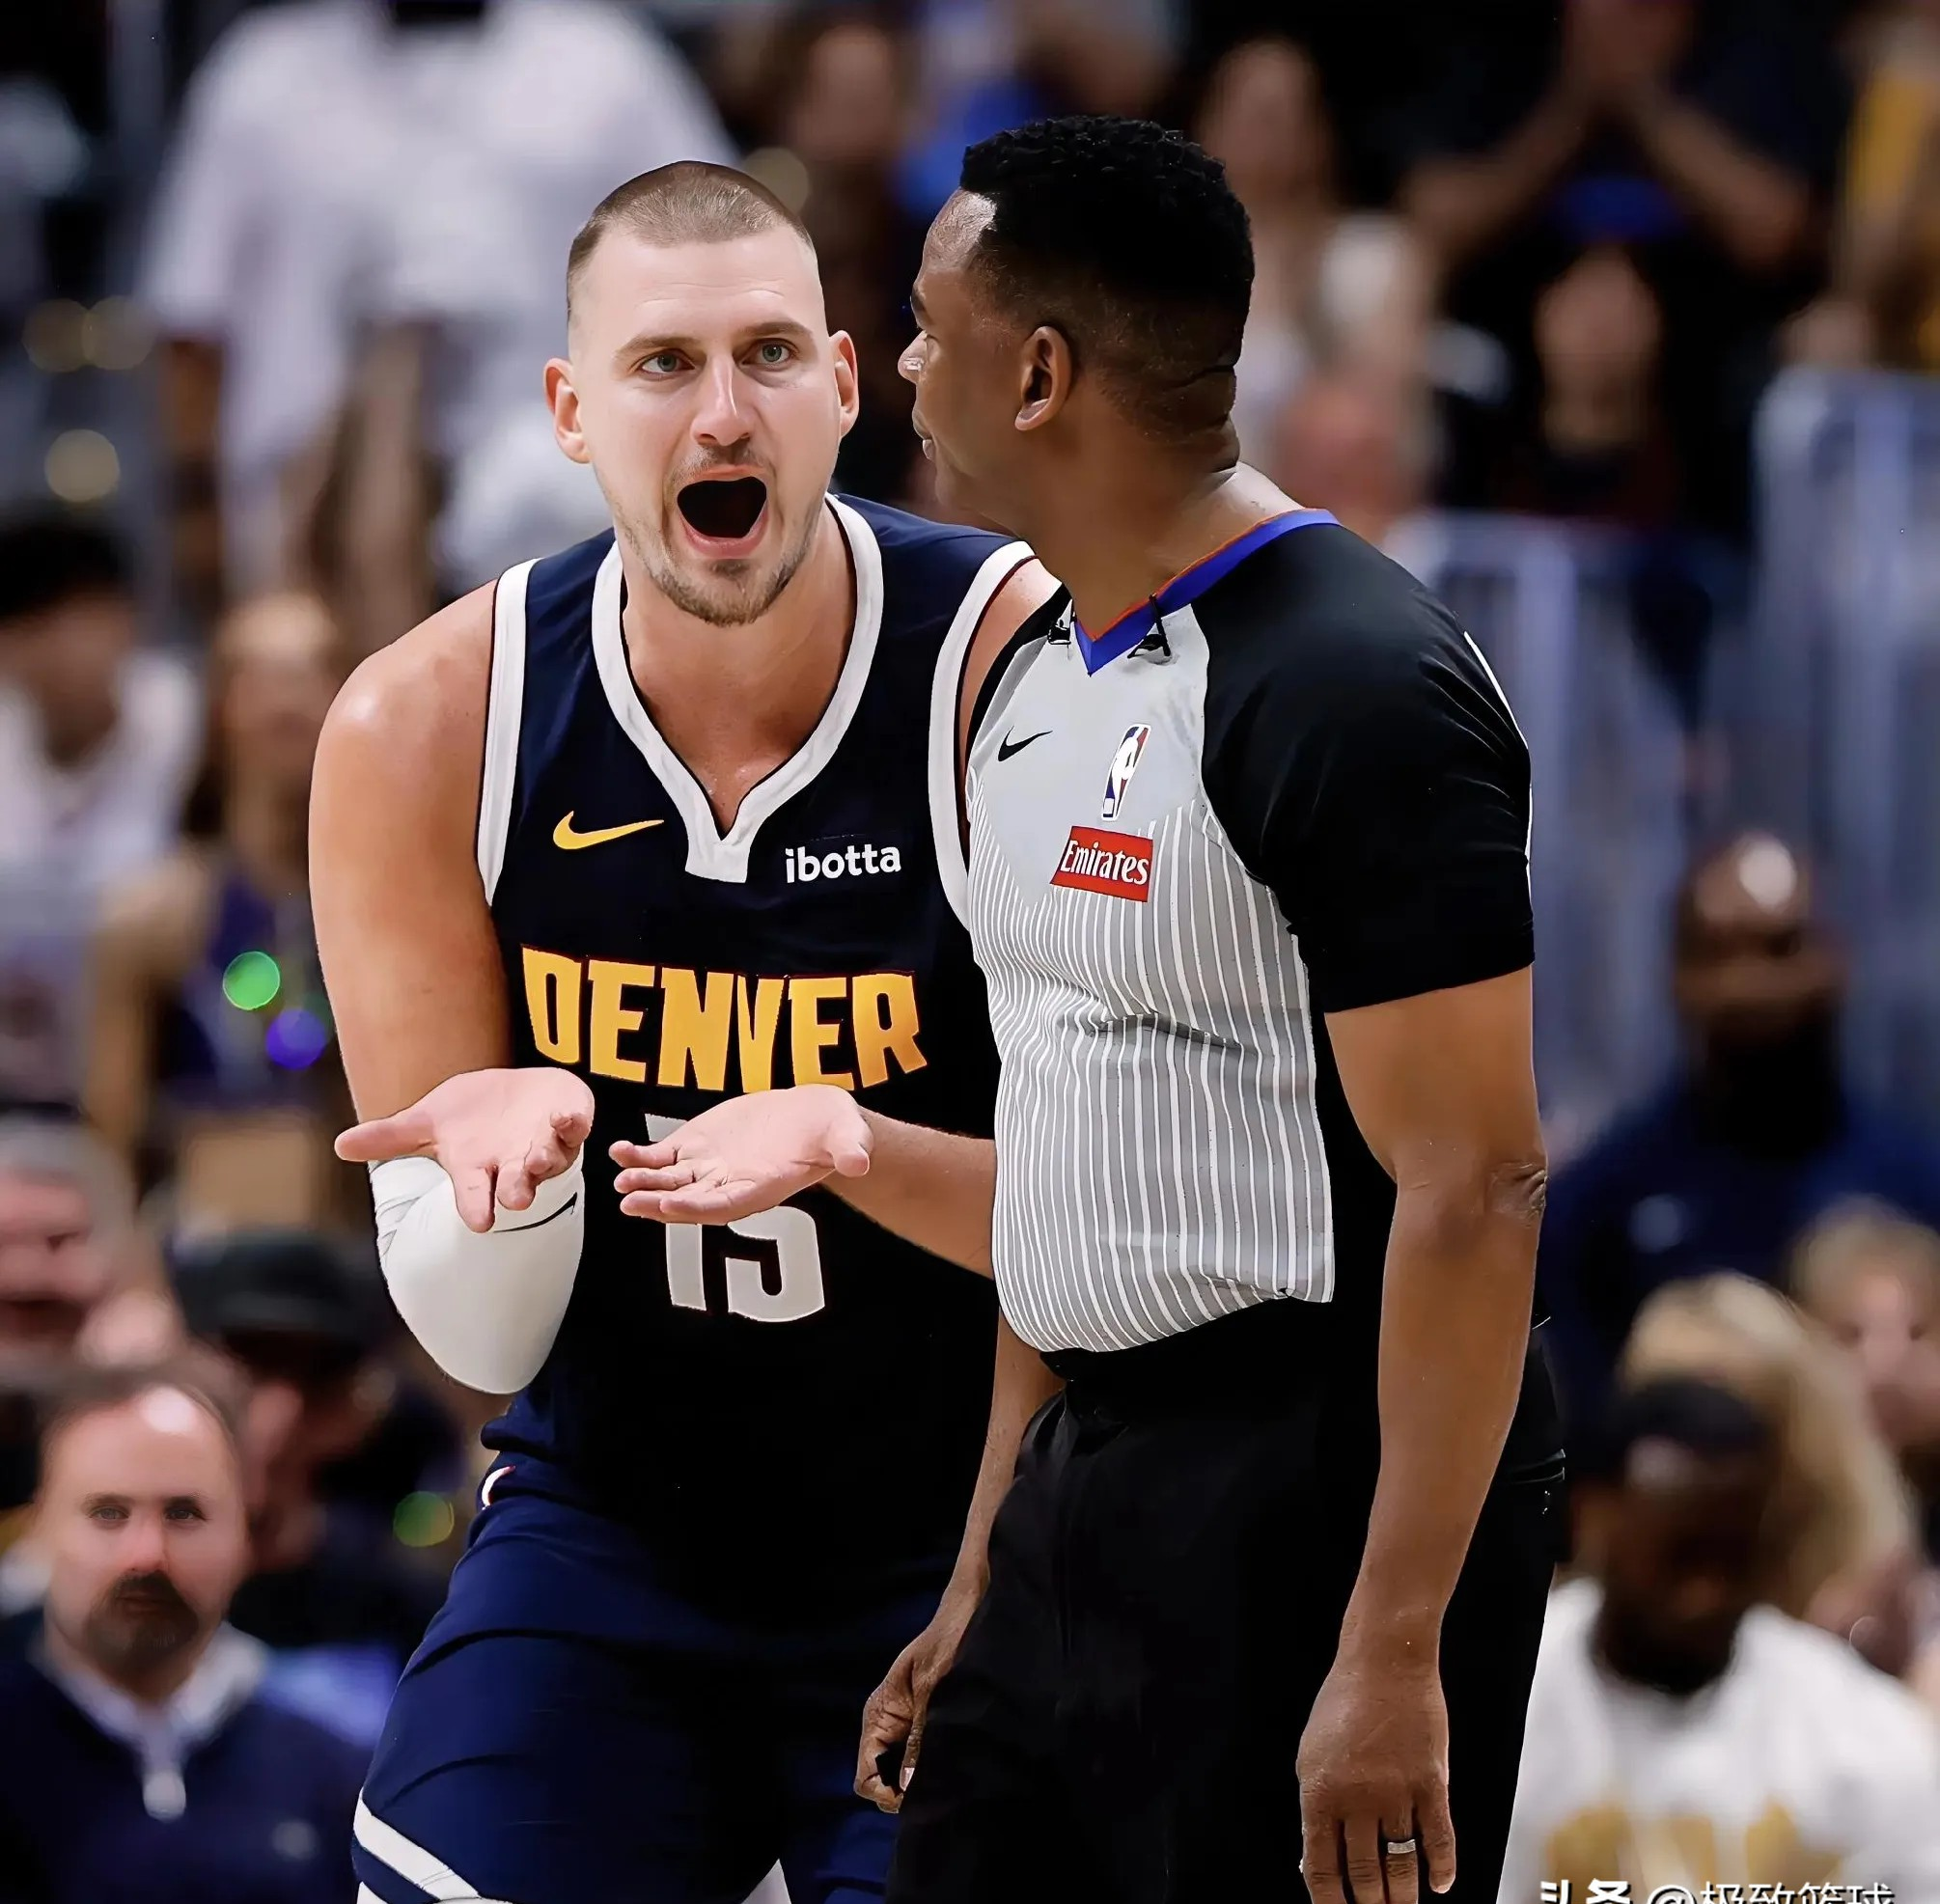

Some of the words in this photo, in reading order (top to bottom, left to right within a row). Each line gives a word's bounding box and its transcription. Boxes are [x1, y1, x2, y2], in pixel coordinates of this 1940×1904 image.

[785, 843, 902, 884] ibotta
[1060, 839, 1150, 886] Emirates
[522, 947, 928, 1095] DENVER
